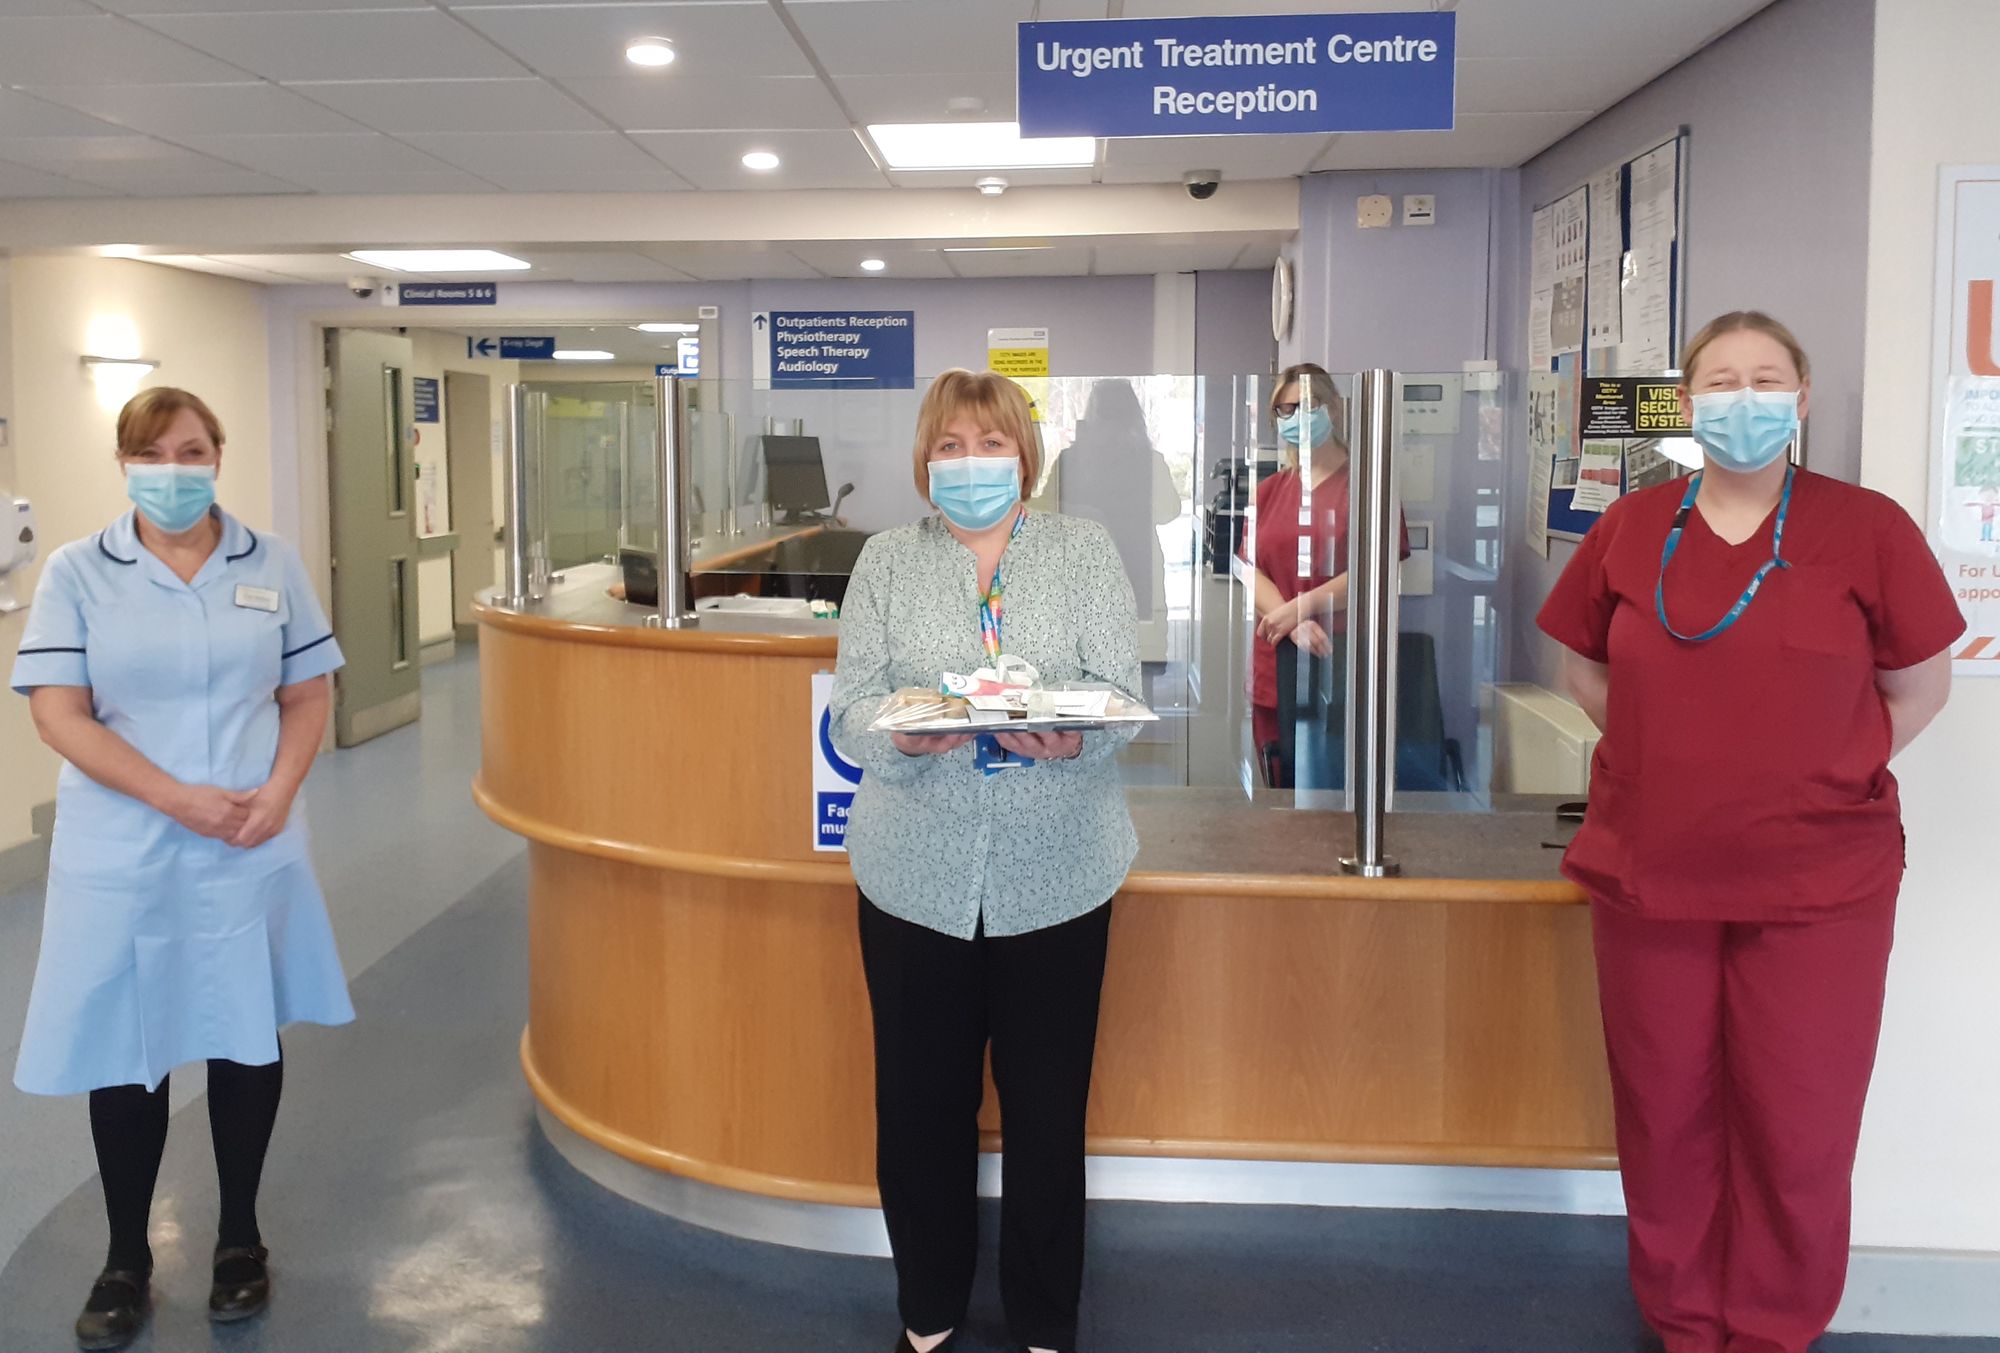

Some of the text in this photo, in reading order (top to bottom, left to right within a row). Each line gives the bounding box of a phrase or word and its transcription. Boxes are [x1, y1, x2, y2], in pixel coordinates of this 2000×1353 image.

[1036, 34, 1438, 78] Urgent Treatment Centre
[1153, 84, 1318, 120] Reception
[403, 289, 435, 299] Clinical
[436, 289, 467, 299] Rooms
[776, 315, 908, 329] Outpatients Reception
[776, 331, 861, 345] Physiotherapy
[777, 346, 870, 360] Speech Therapy
[660, 367, 679, 375] Outp
[777, 361, 839, 374] Audiology
[1640, 401, 1681, 414] SECU
[1640, 415, 1688, 427] SYSTE
[1959, 564, 1986, 578] For
